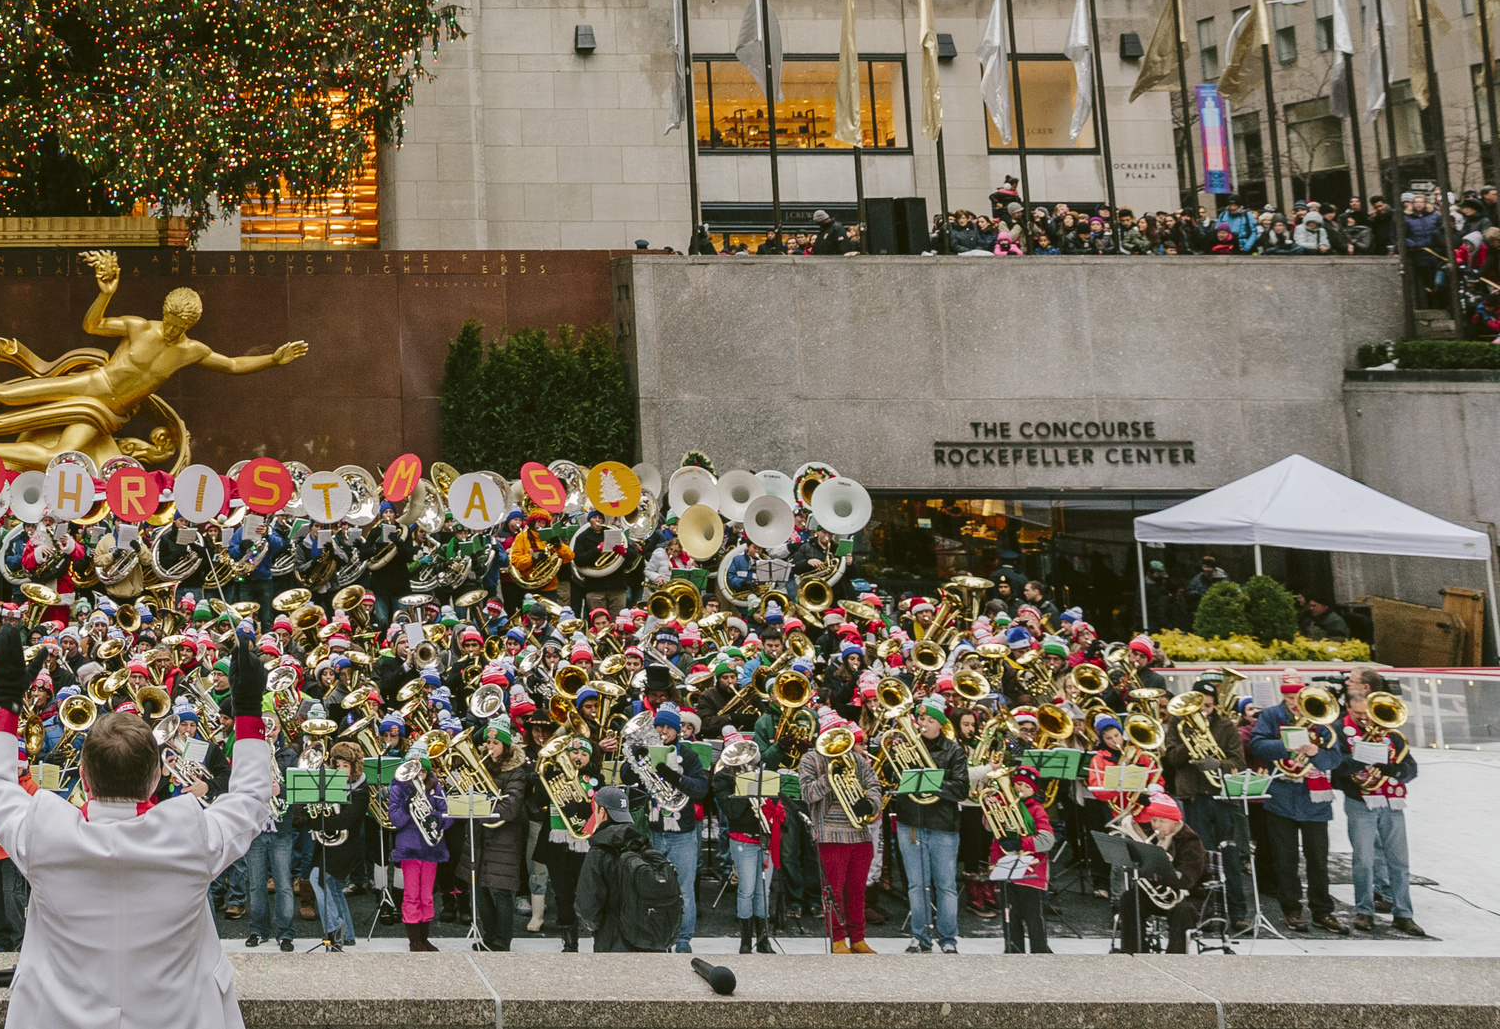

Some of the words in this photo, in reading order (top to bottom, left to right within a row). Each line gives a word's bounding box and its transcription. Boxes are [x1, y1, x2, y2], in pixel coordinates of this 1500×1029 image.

[152, 255, 196, 263] ART
[385, 254, 429, 262] THE
[461, 254, 526, 262] FIRE
[171, 266, 255, 274] MEANS
[288, 266, 314, 274] TO
[482, 265, 546, 274] ENDS
[969, 422, 1011, 439] THE
[1019, 421, 1156, 439] CONCOURSE
[934, 448, 1094, 467] ROCKEFELLER
[1105, 448, 1196, 465] CENTER
